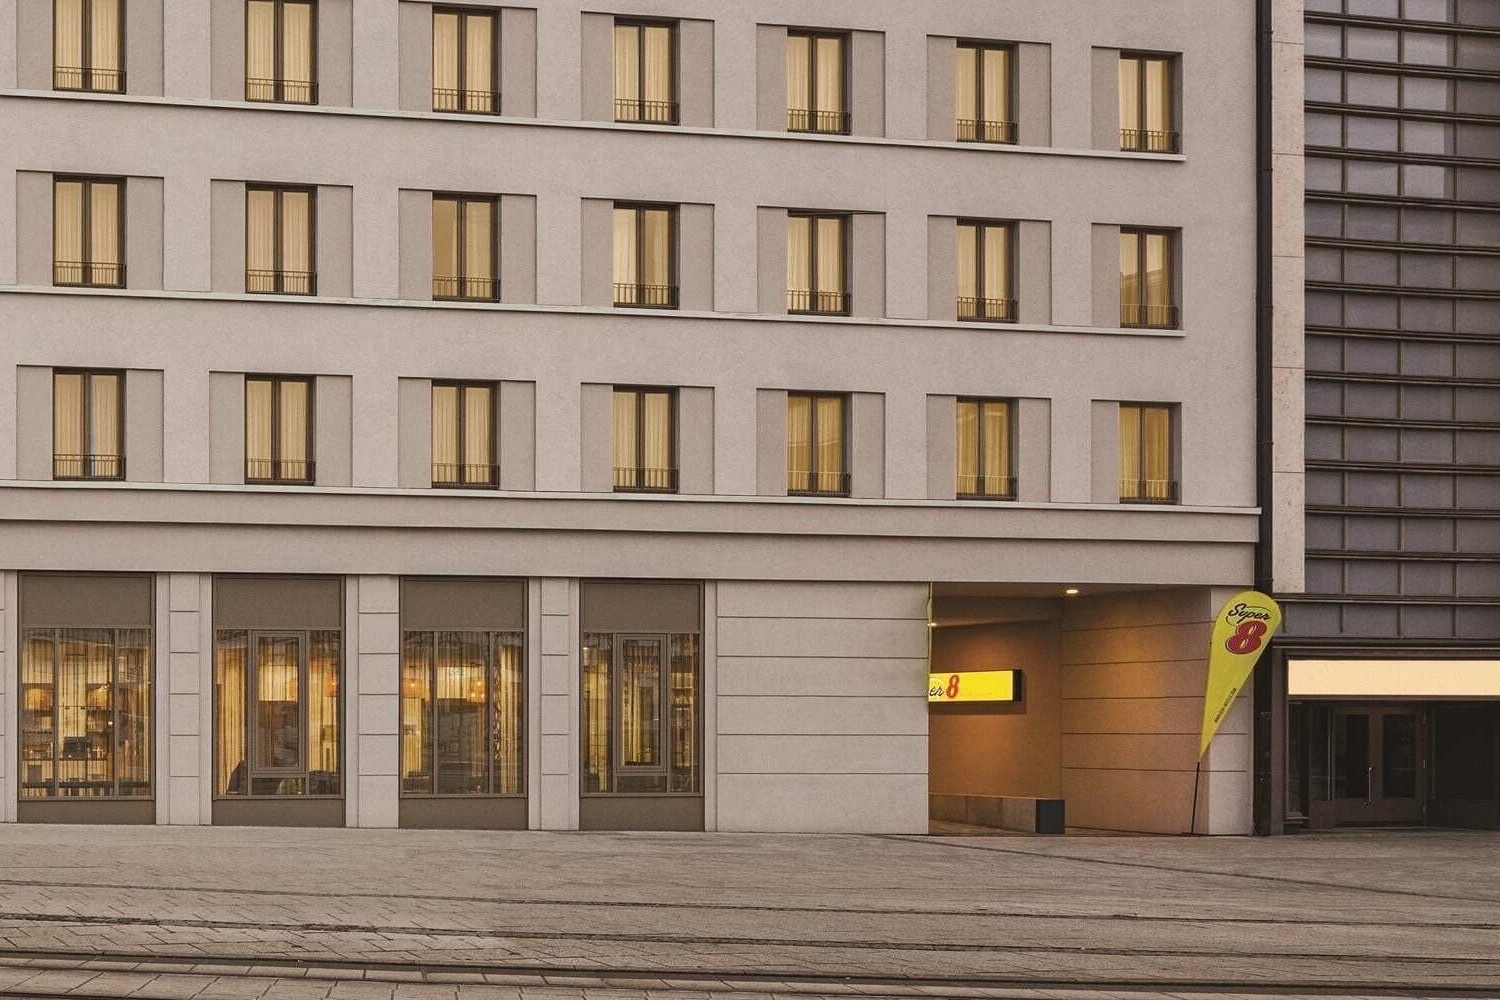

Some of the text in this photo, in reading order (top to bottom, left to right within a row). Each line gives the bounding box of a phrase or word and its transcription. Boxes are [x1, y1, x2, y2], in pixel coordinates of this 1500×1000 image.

[1227, 603, 1272, 624] Super
[1225, 620, 1268, 655] 8
[929, 674, 960, 699] er 8
